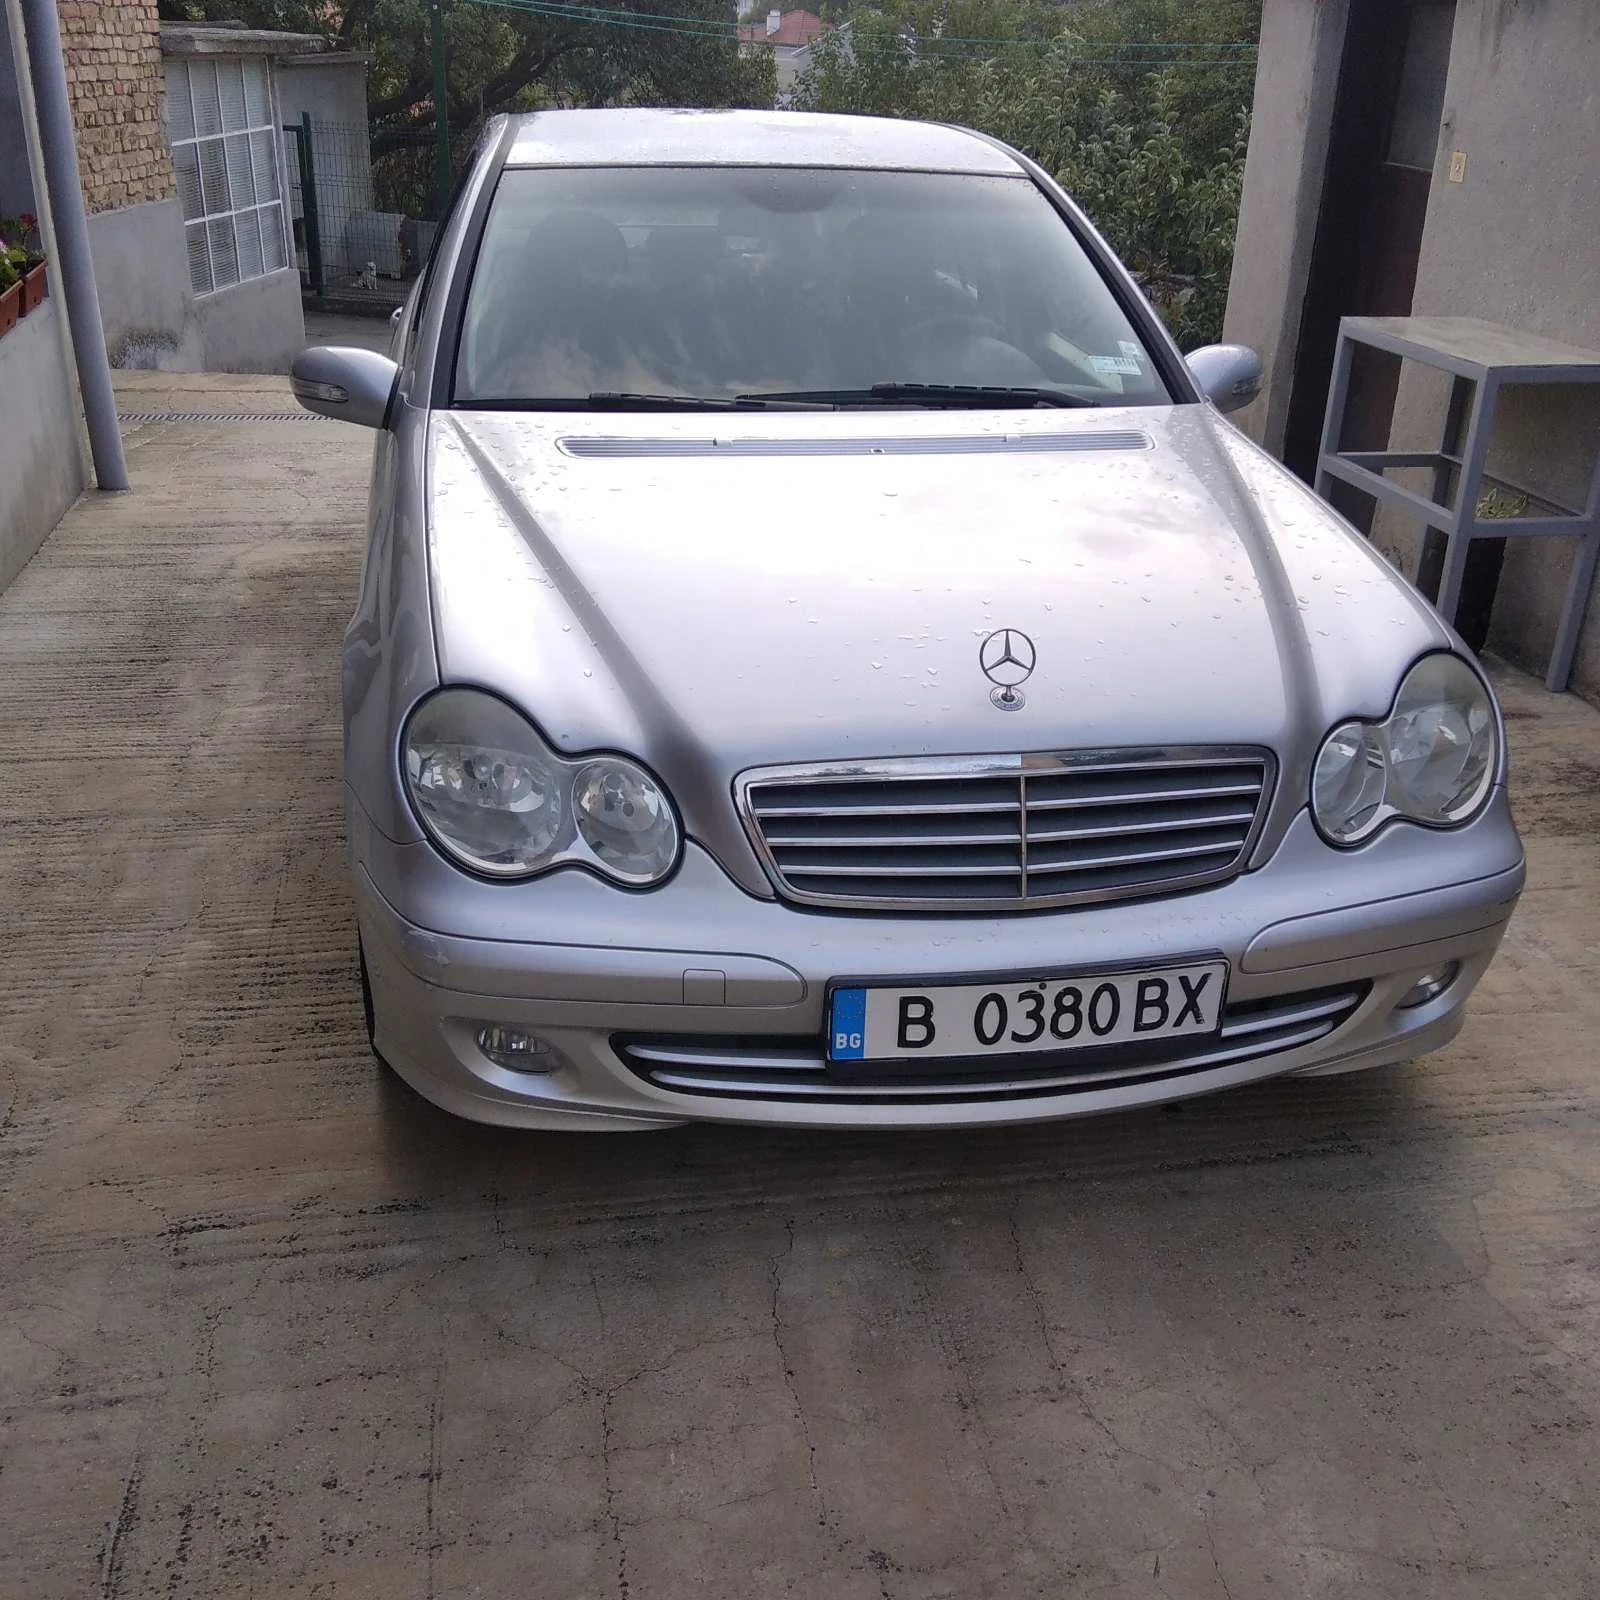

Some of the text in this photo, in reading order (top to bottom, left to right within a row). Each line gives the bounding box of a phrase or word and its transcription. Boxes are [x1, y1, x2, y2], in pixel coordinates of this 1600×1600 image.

[896, 971, 1212, 1049] B 0380 BX
[835, 1033, 862, 1050] BG
